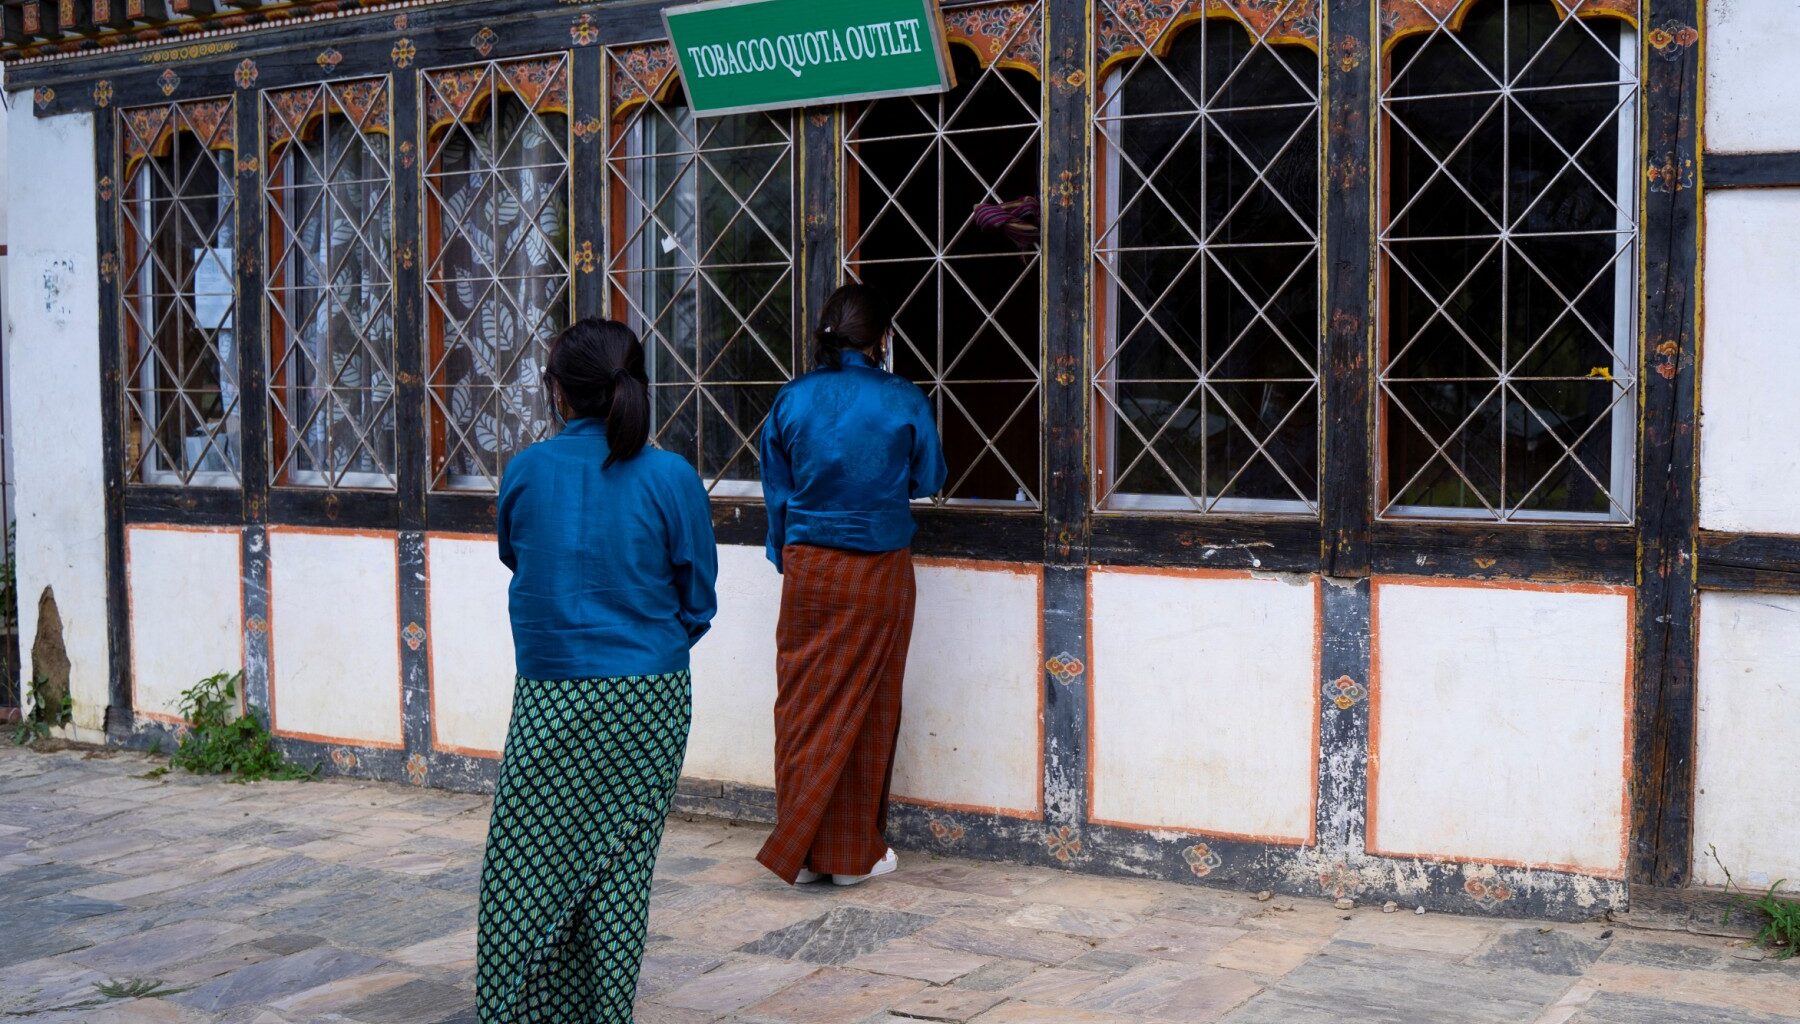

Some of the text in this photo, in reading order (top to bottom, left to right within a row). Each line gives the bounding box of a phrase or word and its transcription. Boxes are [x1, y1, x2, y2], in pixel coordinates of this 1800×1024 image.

[687, 18, 922, 78] TOBACCO QUOTA OUTLET
